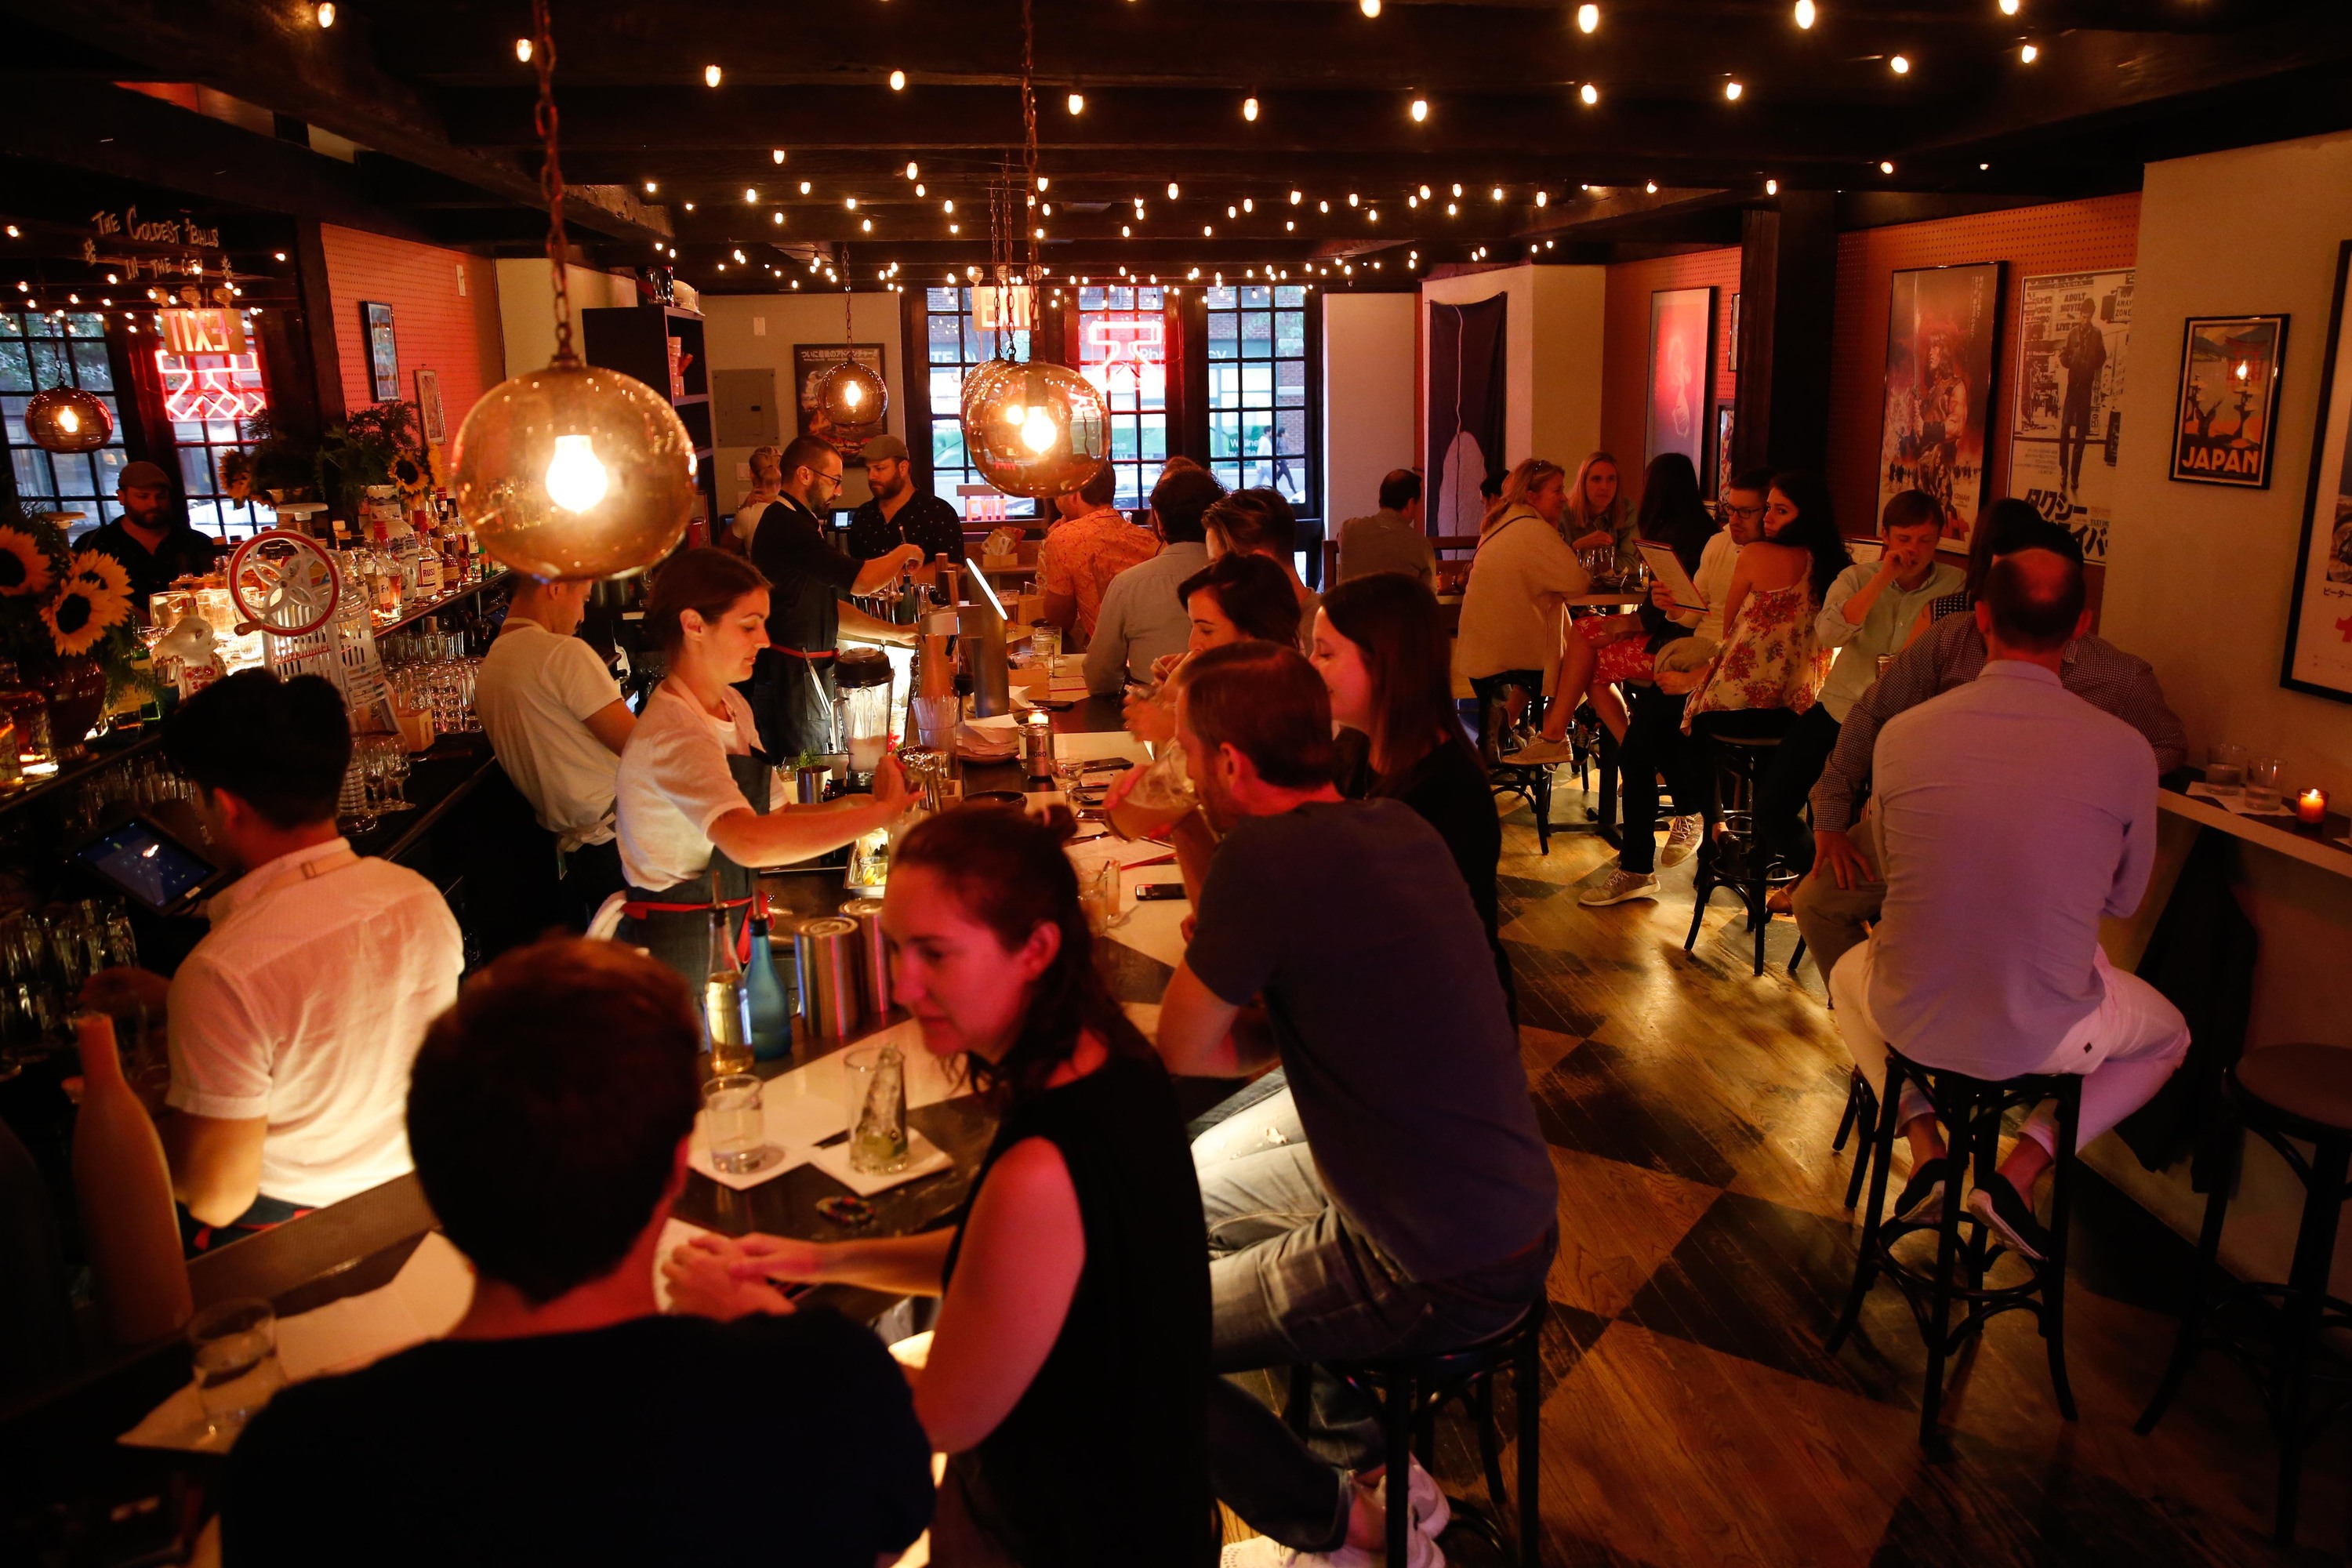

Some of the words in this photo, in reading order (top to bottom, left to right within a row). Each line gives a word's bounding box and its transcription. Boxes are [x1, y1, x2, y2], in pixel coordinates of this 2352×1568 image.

[91, 210, 120, 235] THE
[126, 204, 180, 245] COLDEST
[125, 256, 140, 281] IN
[151, 257, 172, 279] THE
[981, 286, 1033, 328] EXIT
[2063, 292, 2086, 303] ADULT
[2182, 446, 2259, 474] JAPAN
[966, 499, 1008, 522] EXIT
[2024, 488, 2088, 521] タクシー
